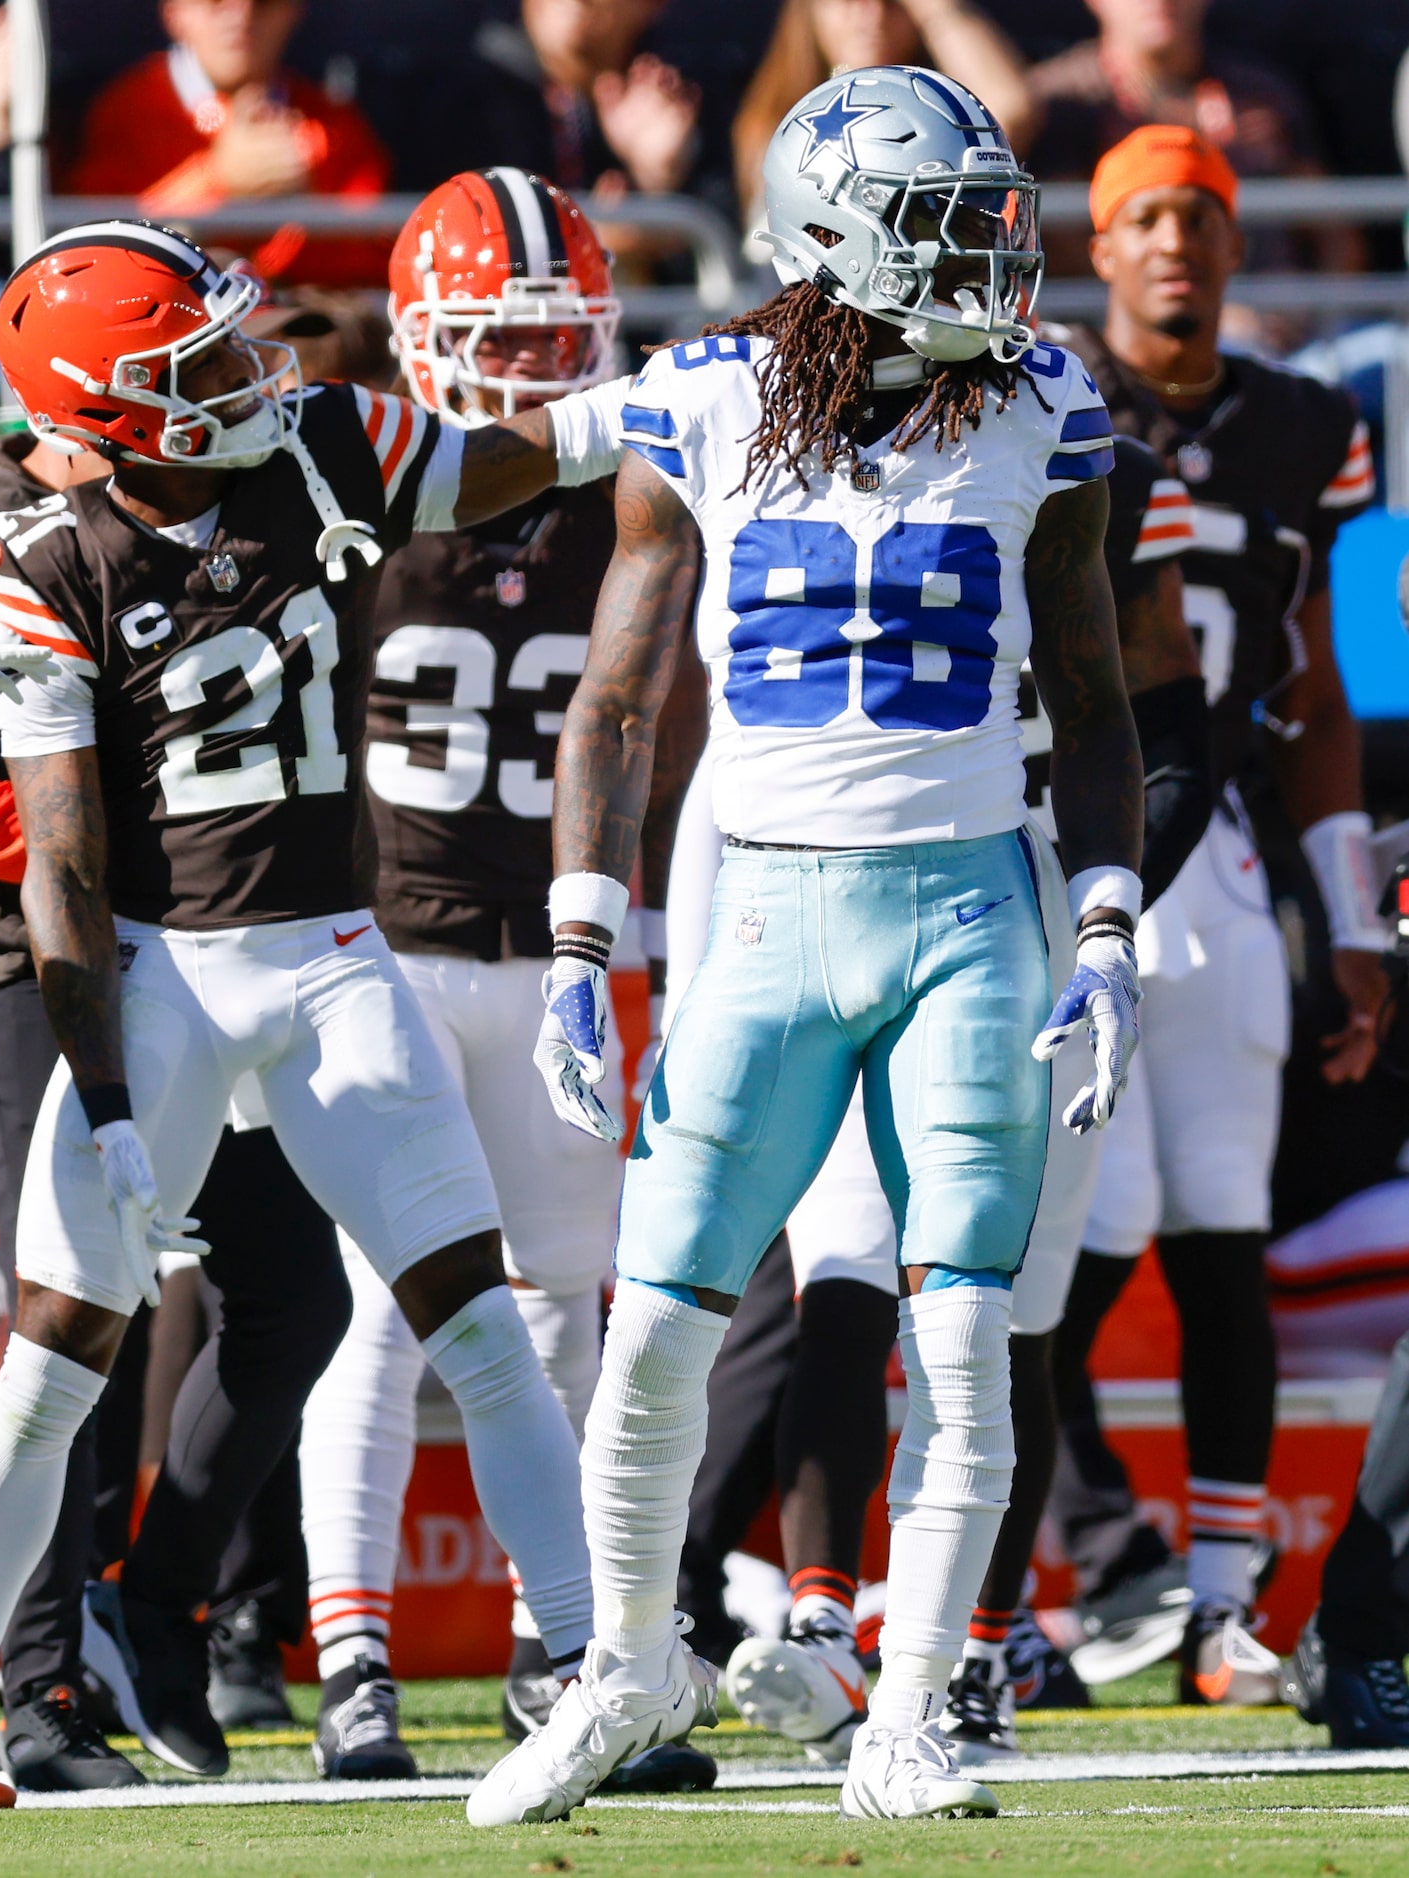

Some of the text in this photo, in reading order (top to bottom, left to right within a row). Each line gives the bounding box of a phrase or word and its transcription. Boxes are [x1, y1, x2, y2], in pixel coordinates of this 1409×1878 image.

[856, 475, 878, 489] NFL
[120, 602, 172, 649] C
[158, 585, 347, 815] 21
[366, 624, 591, 819] 33
[723, 518, 1002, 732] 88
